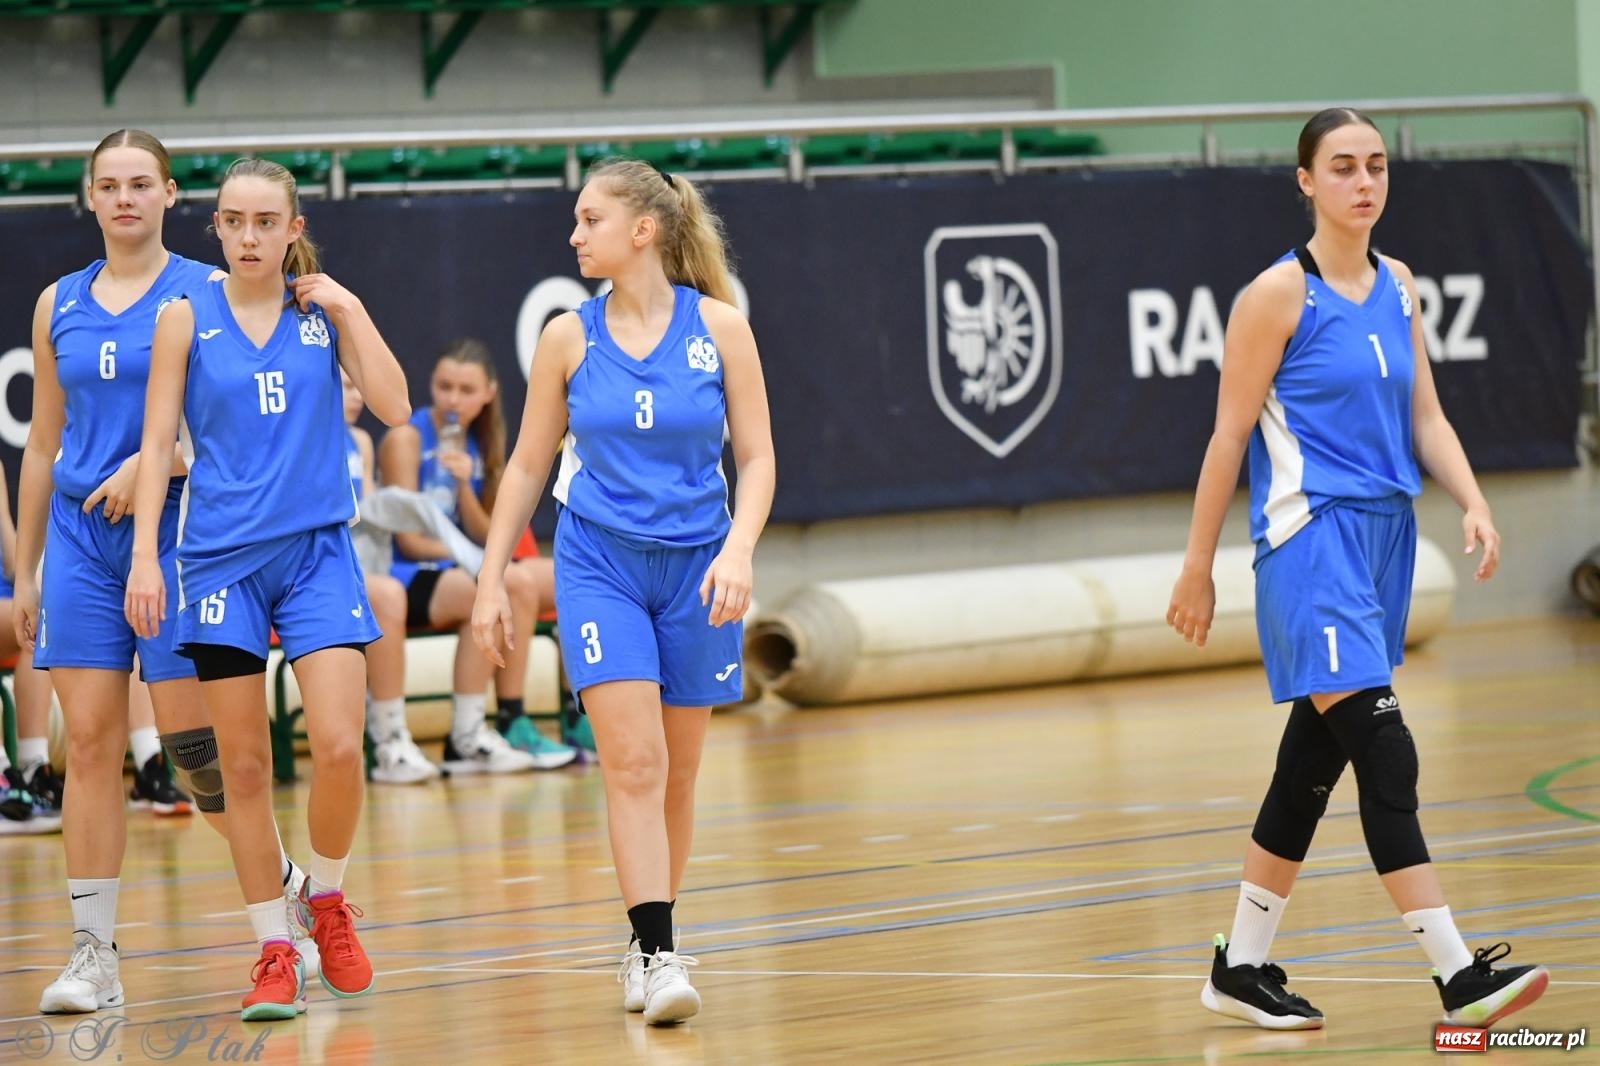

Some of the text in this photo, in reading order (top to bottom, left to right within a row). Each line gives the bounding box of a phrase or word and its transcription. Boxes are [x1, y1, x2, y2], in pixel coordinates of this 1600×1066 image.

[99, 341, 117, 380] 6
[1367, 333, 1388, 378] 1
[254, 370, 287, 415] 15
[634, 389, 655, 430] 3
[580, 621, 602, 664] 3
[1323, 626, 1339, 673] 1
